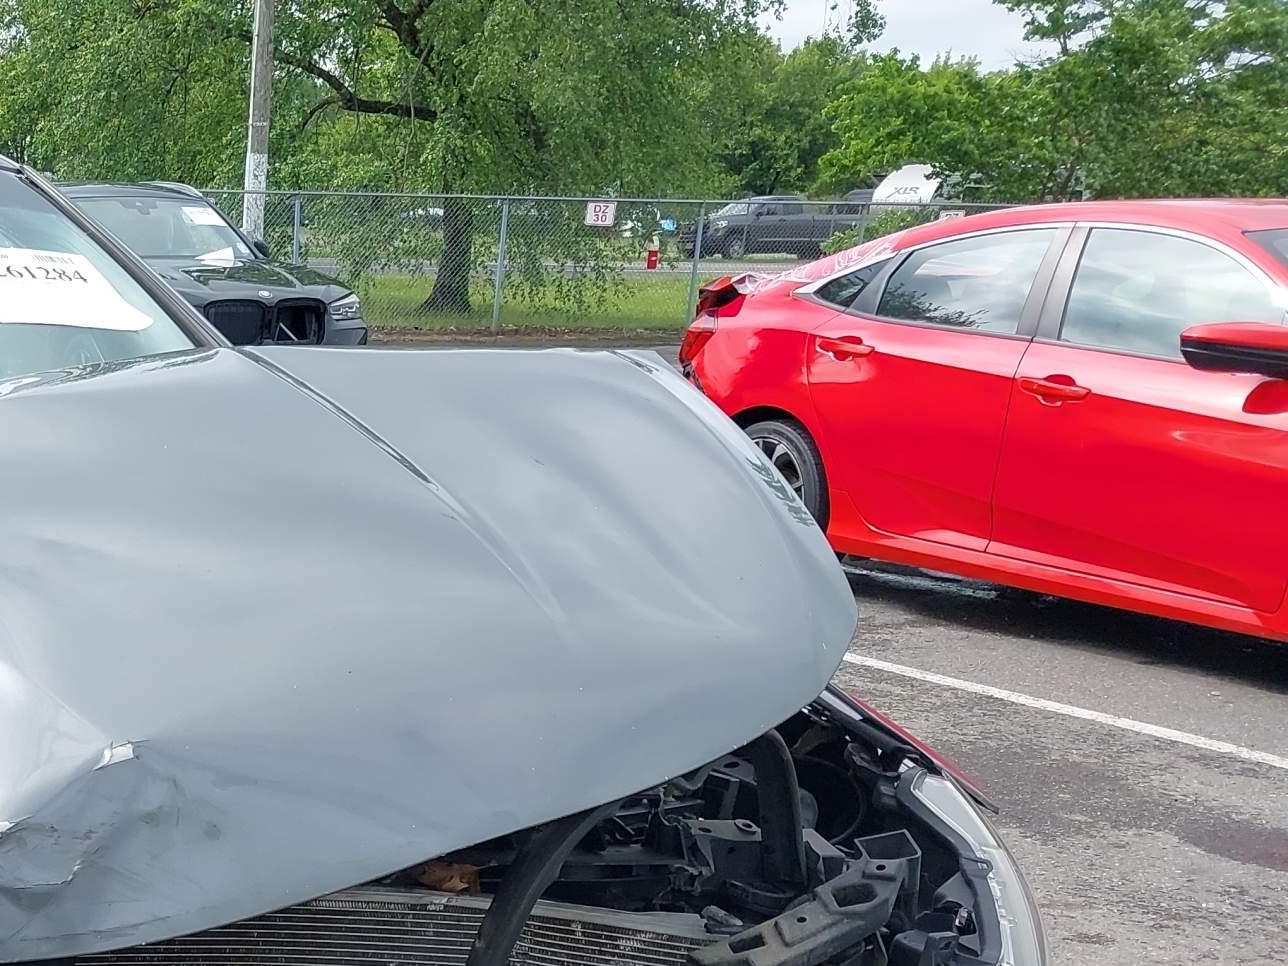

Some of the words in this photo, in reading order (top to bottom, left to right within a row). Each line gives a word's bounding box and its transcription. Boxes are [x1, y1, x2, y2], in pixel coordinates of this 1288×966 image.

[886, 186, 920, 199] XLR
[593, 204, 610, 214] DZ
[592, 214, 608, 223] 30
